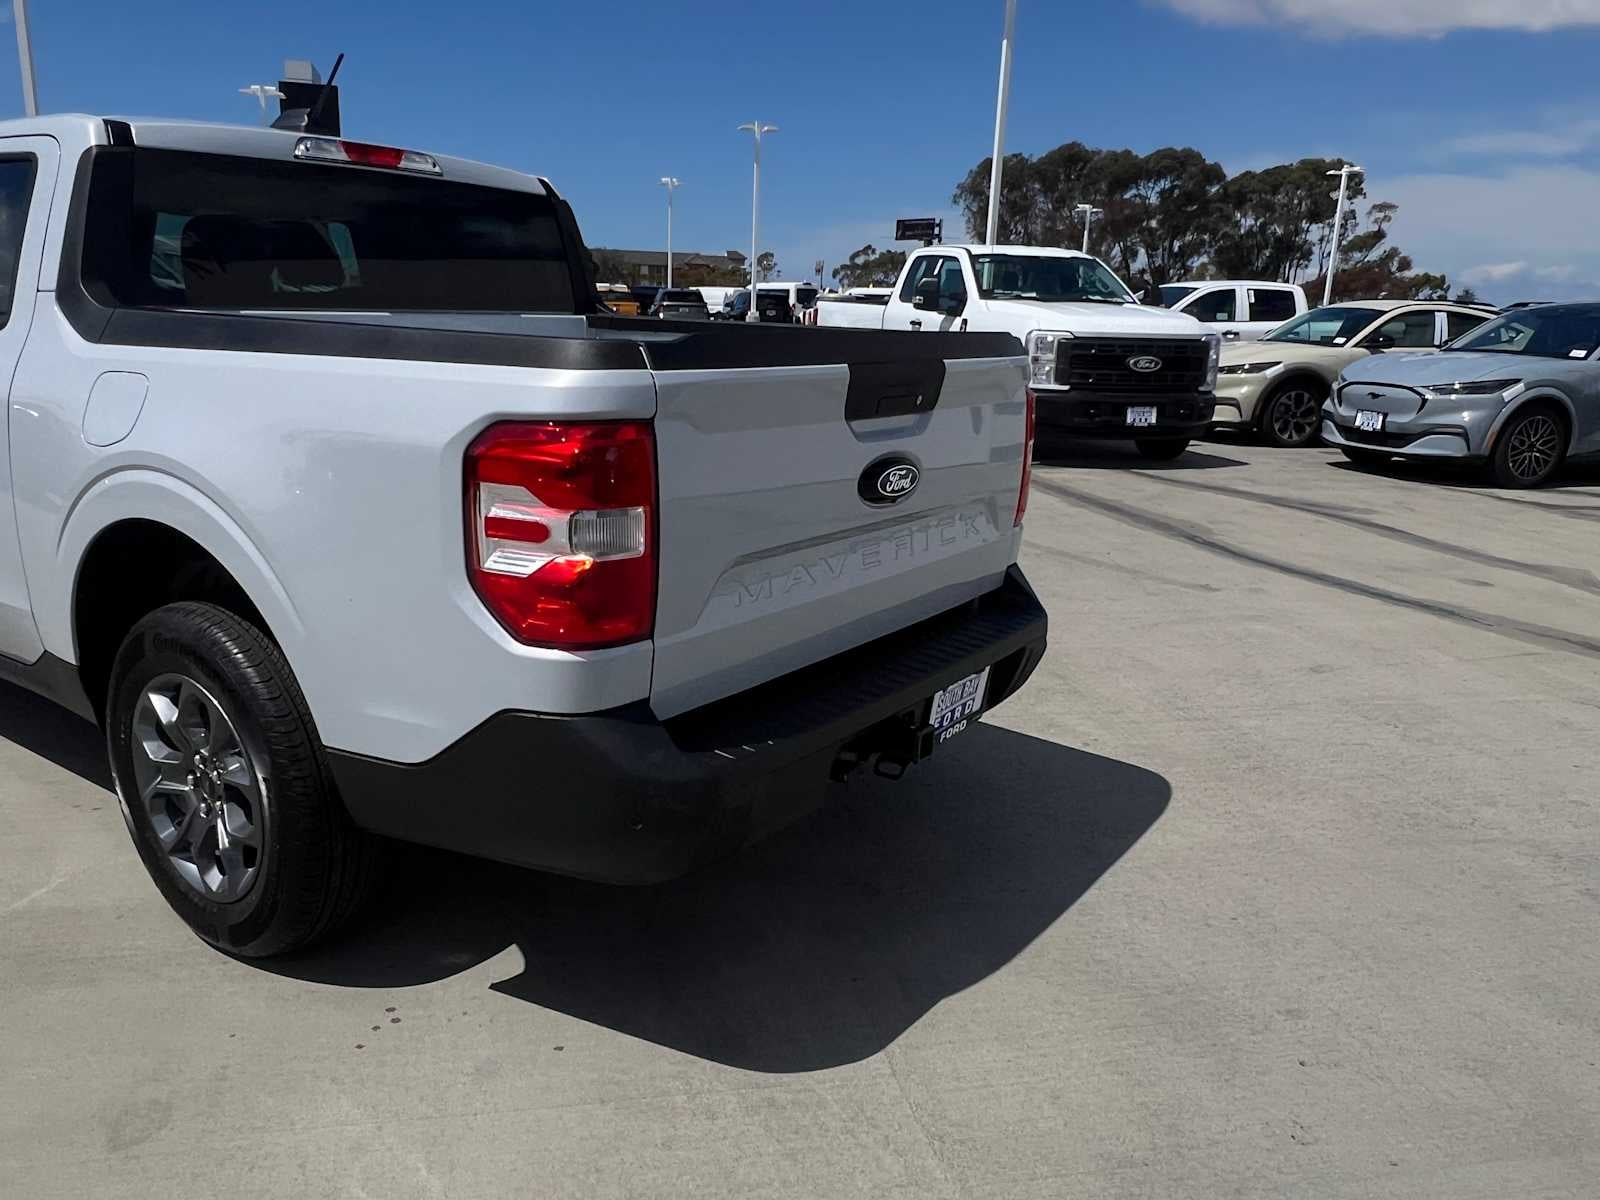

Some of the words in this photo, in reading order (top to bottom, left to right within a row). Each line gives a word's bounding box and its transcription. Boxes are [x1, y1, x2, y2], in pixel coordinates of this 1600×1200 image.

[886, 470, 912, 492] Ford
[735, 513, 982, 607] MAVERICK
[940, 719, 967, 743] FORD
